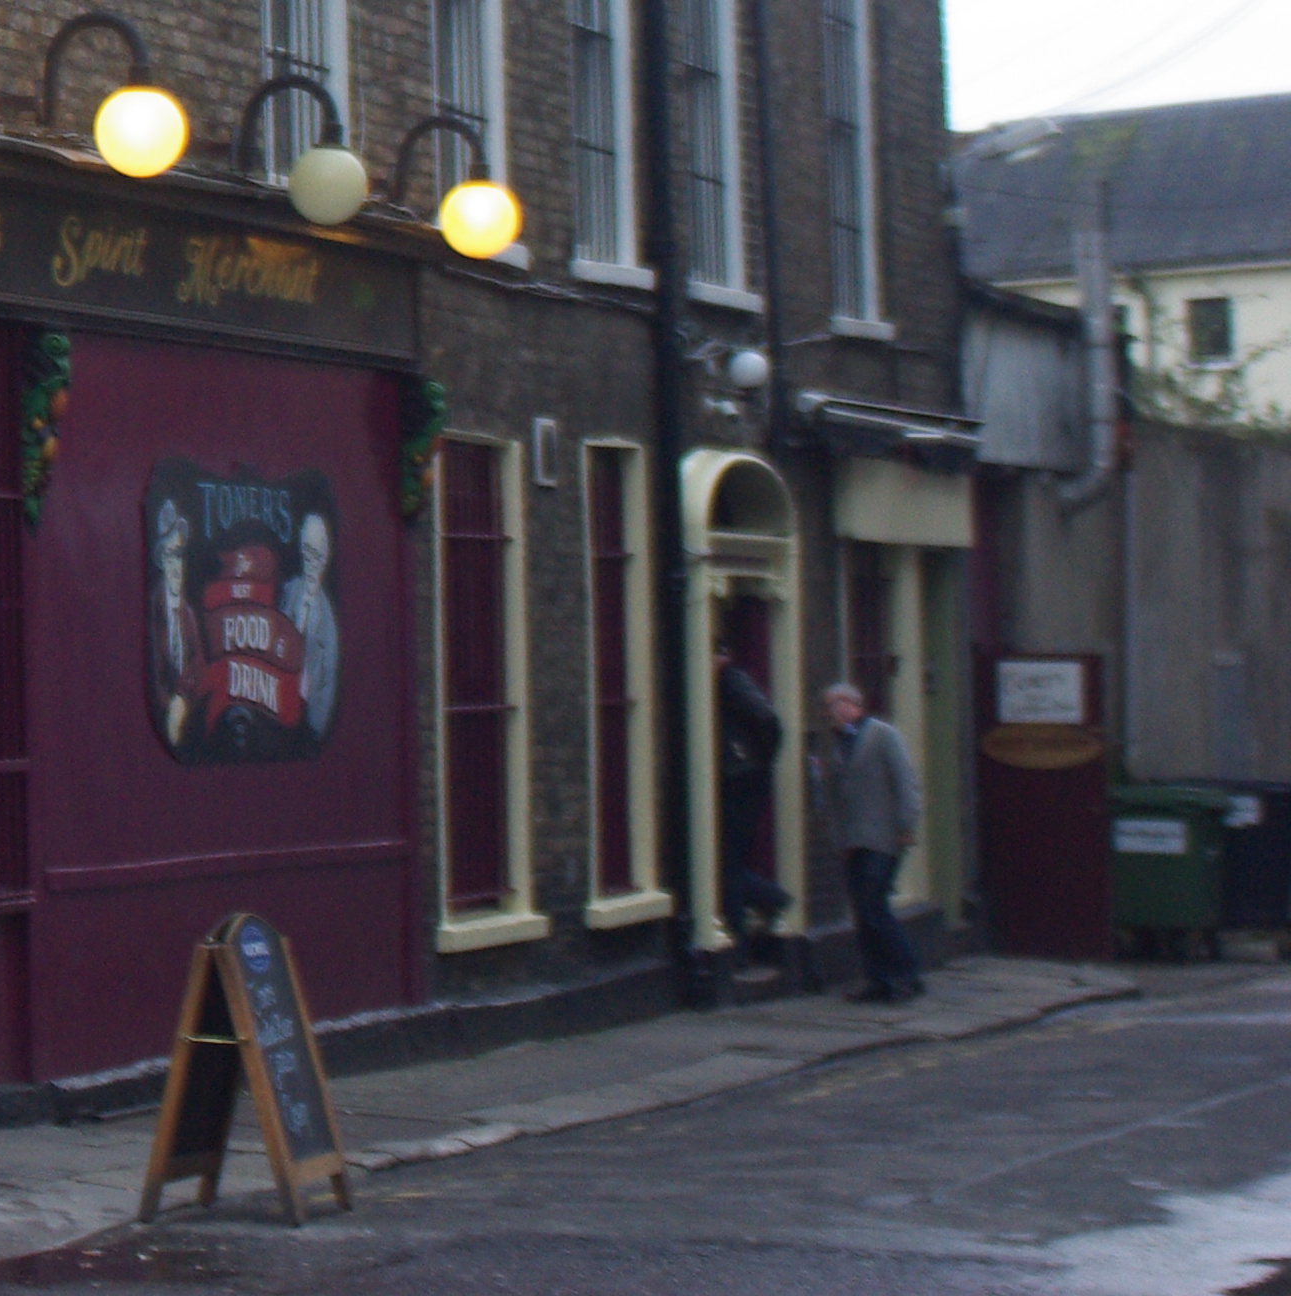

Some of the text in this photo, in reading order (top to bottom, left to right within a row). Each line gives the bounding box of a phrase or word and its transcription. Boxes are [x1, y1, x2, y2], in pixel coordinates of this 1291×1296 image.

[51, 215, 148, 288] Spirit
[223, 614, 271, 652] FOOD
[228, 661, 280, 715] DRINK
